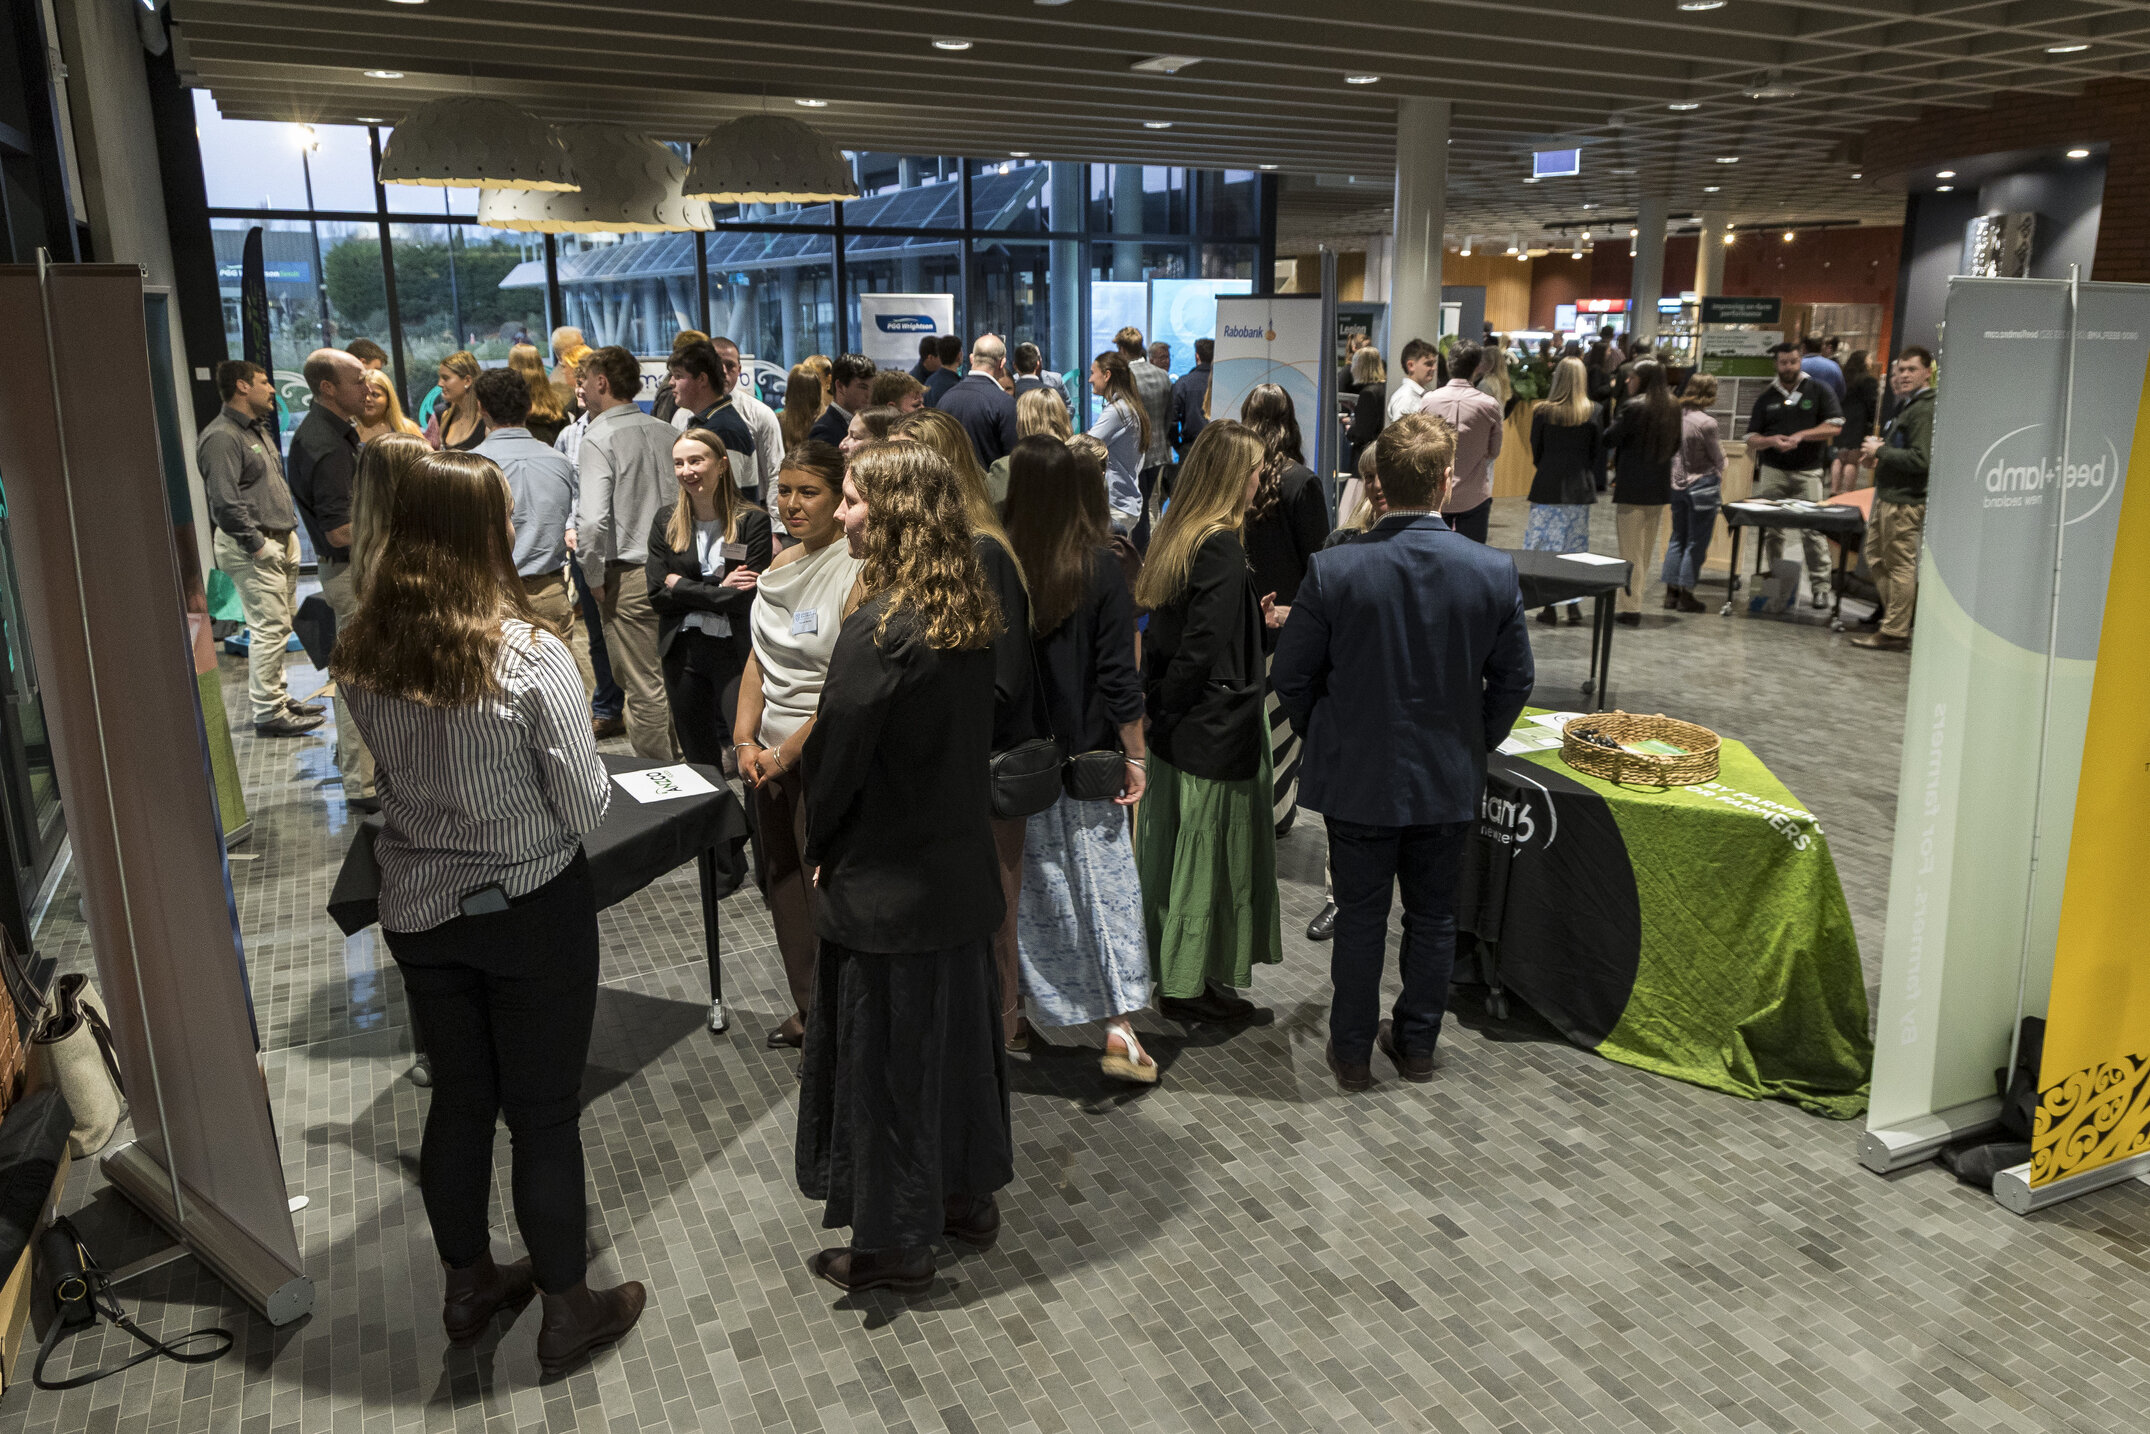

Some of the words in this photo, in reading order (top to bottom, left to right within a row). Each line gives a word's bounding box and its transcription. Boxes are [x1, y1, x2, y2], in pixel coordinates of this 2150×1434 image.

[902, 323, 934, 331] Wrightson
[1224, 325, 1263, 338] Rabobank
[1702, 782, 1736, 792] BY
[1684, 785, 1717, 797] OR
[1715, 796, 1812, 851] FARMERS
